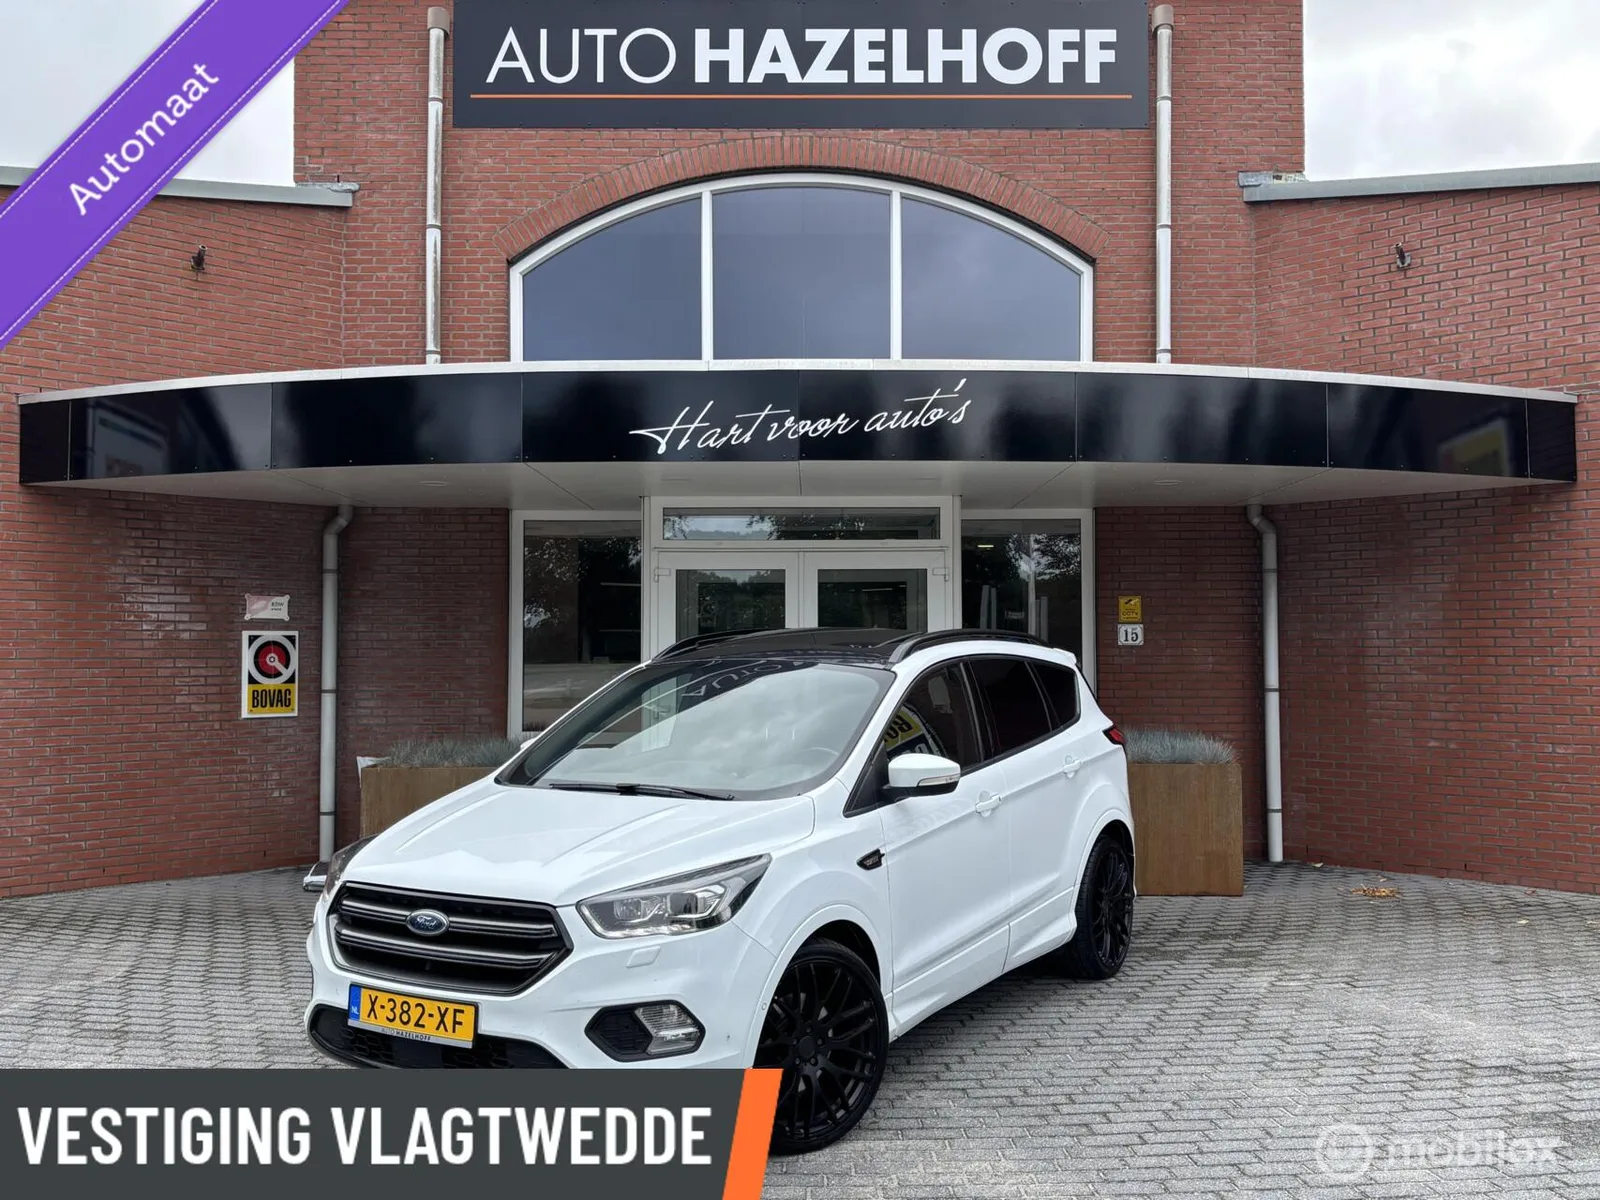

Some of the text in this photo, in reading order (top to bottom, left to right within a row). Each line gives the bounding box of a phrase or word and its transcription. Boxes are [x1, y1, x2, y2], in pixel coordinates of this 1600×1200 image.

[485, 26, 1117, 84] AUTO HAZELHOFF
[629, 378, 972, 454] Hart voor auto's
[1123, 627, 1139, 643] 15
[251, 688, 292, 709] BOVAG
[351, 993, 465, 1034] NL X-382-XF
[396, 1030, 431, 1042] HAZELHOFF
